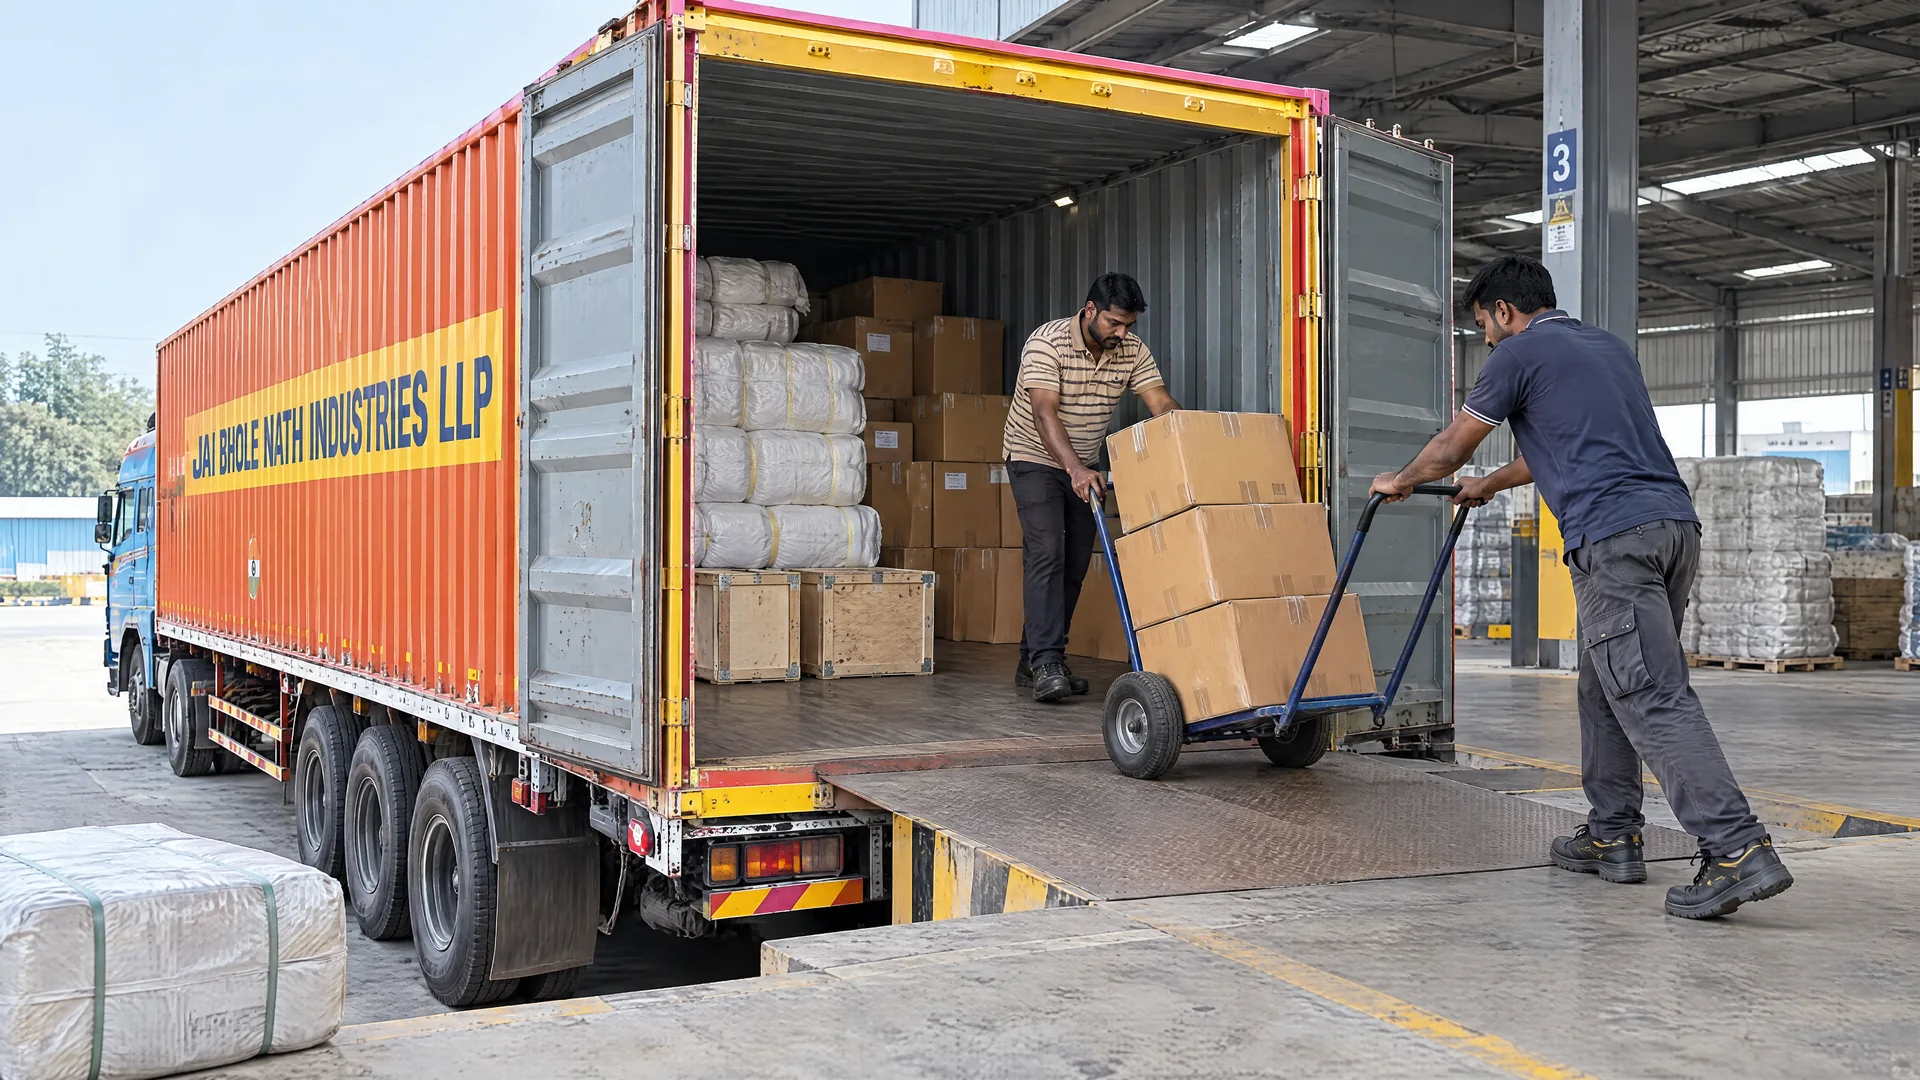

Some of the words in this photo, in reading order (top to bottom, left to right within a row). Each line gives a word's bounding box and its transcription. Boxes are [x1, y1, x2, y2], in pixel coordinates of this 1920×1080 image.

[1553, 143, 1571, 182] 3
[192, 431, 215, 480] JAI
[219, 418, 259, 476] BHOLE
[263, 405, 304, 468] NATH
[309, 369, 429, 461] INDUSTRIES
[439, 354, 493, 443] LLP
